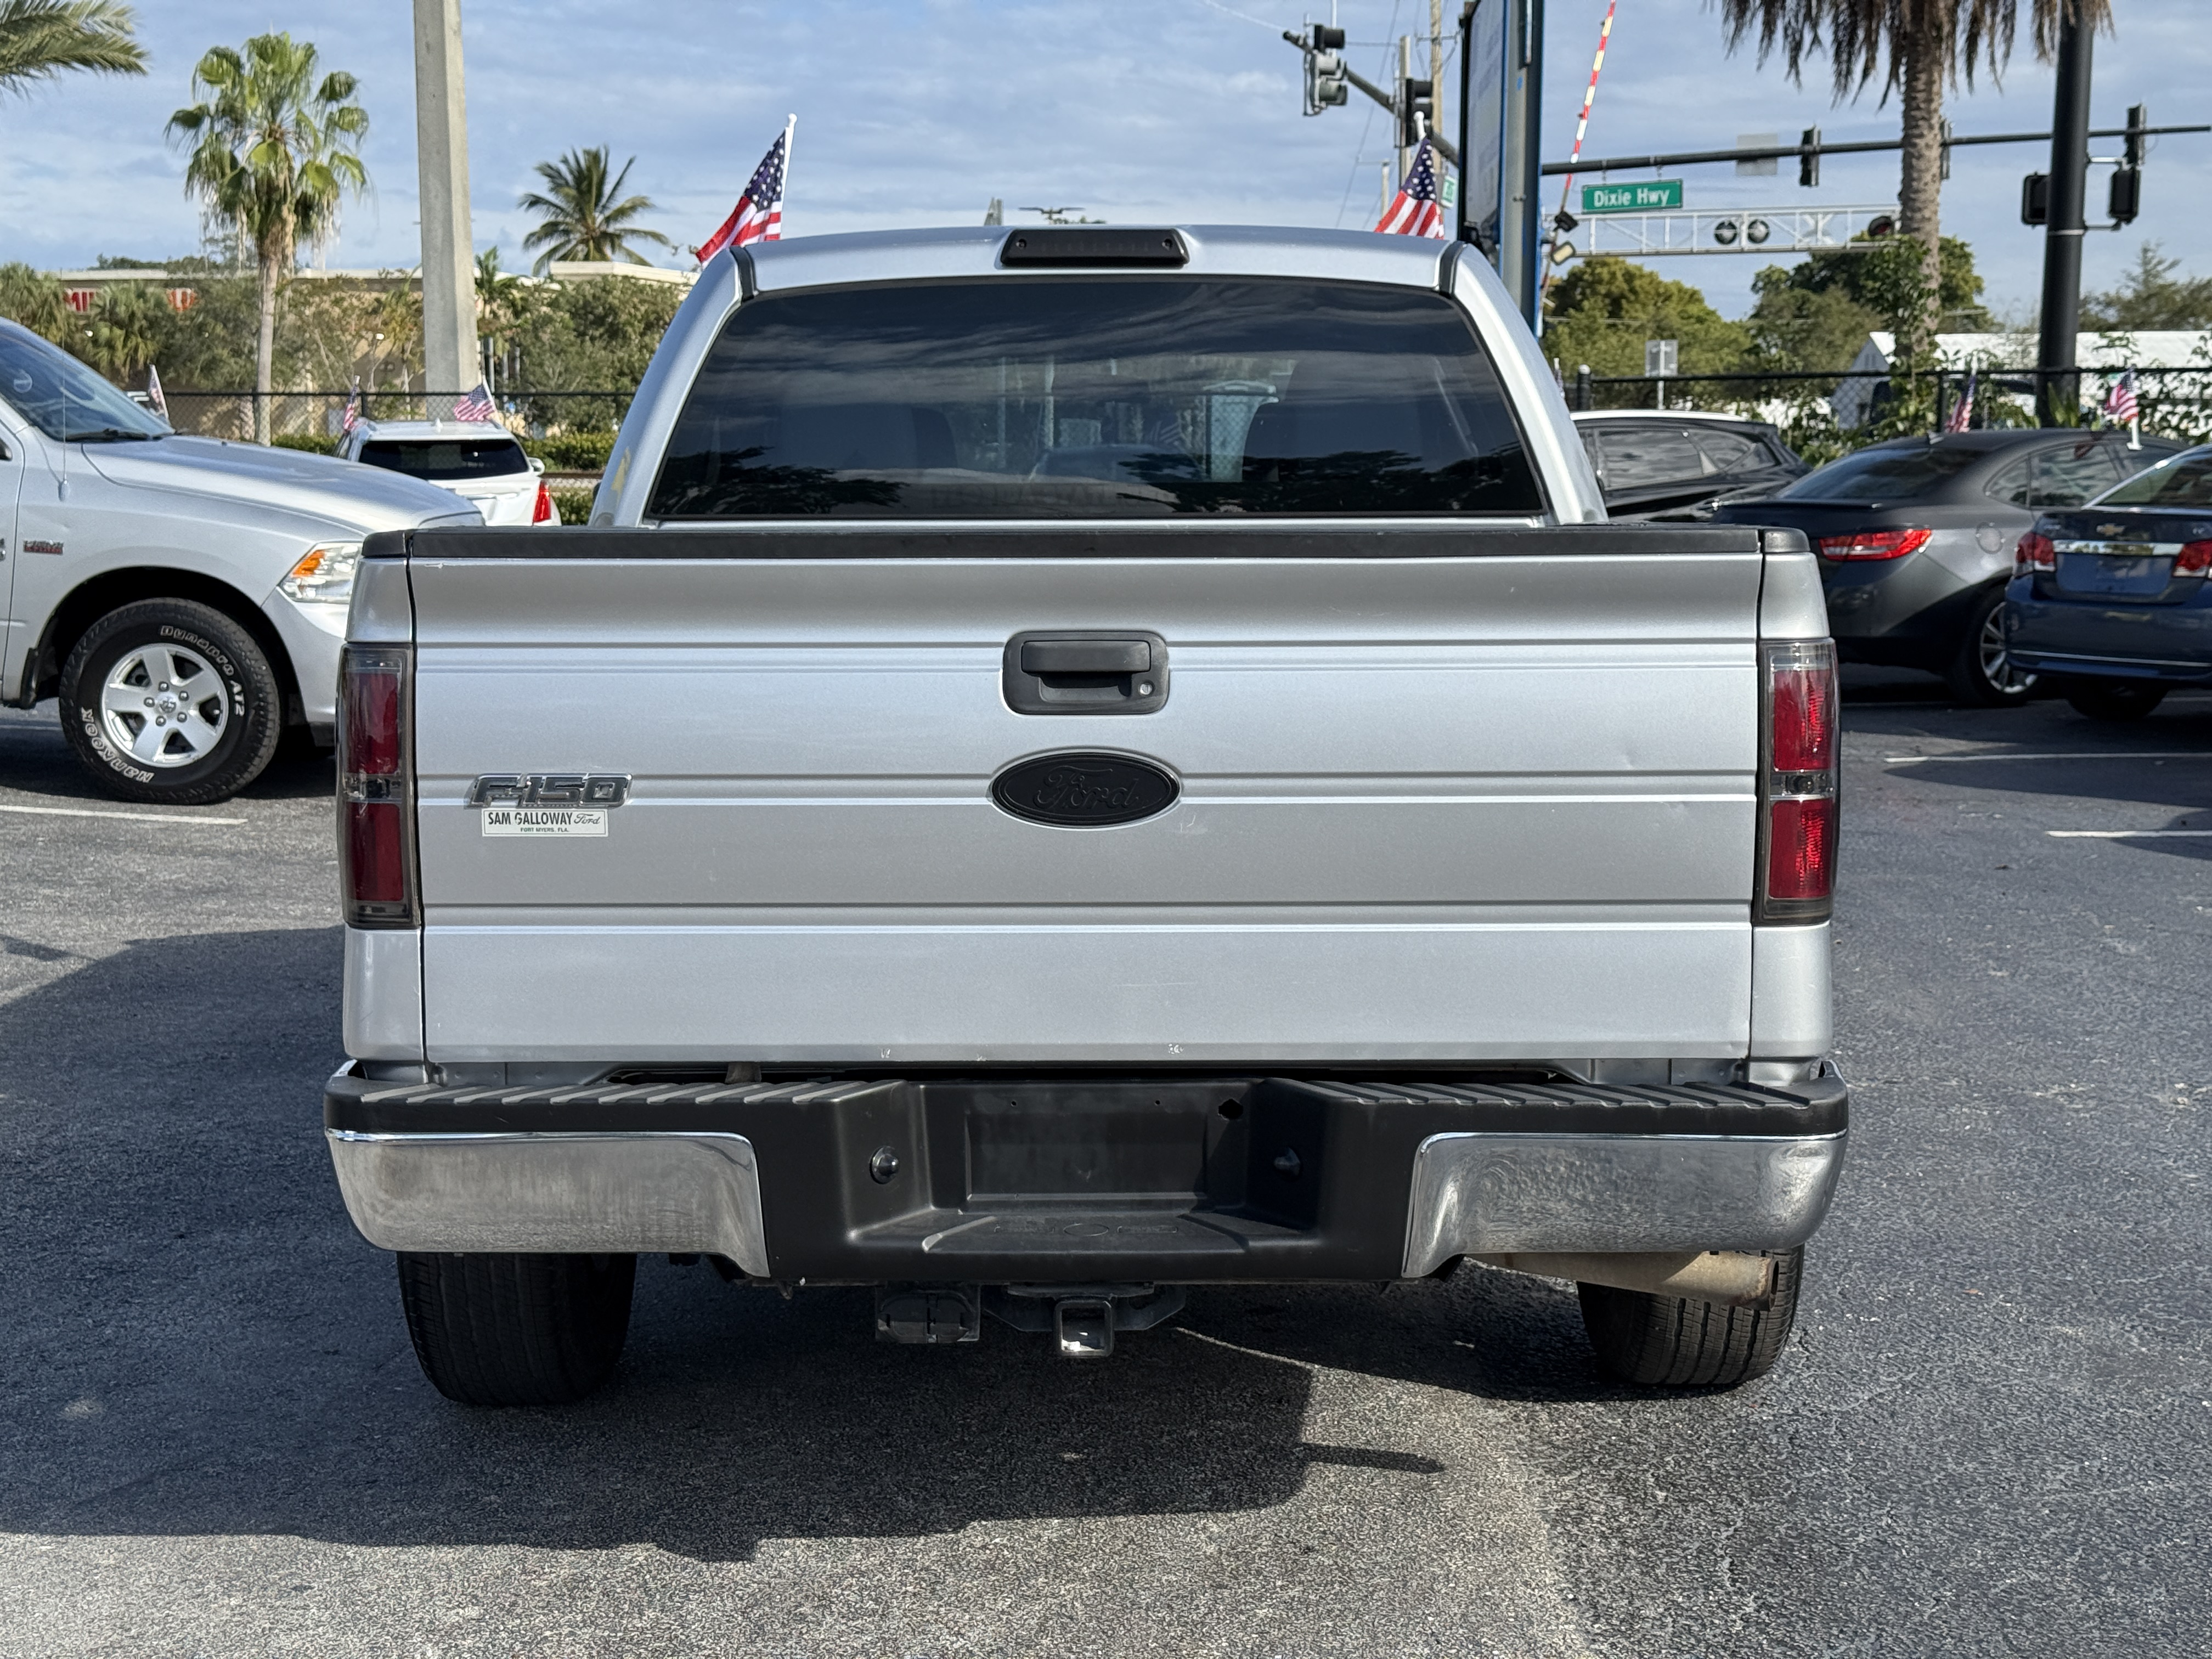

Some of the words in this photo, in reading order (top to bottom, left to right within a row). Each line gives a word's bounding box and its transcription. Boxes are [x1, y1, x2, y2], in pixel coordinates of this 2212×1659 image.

[1594, 189, 1632, 207] Dixie
[1637, 188, 1670, 207] Hwy
[468, 772, 632, 809] F-150
[1034, 765, 1140, 809] Ford
[488, 812, 511, 825] SAM
[515, 812, 573, 825] GALLOWAY
[573, 813, 601, 825] Ford
